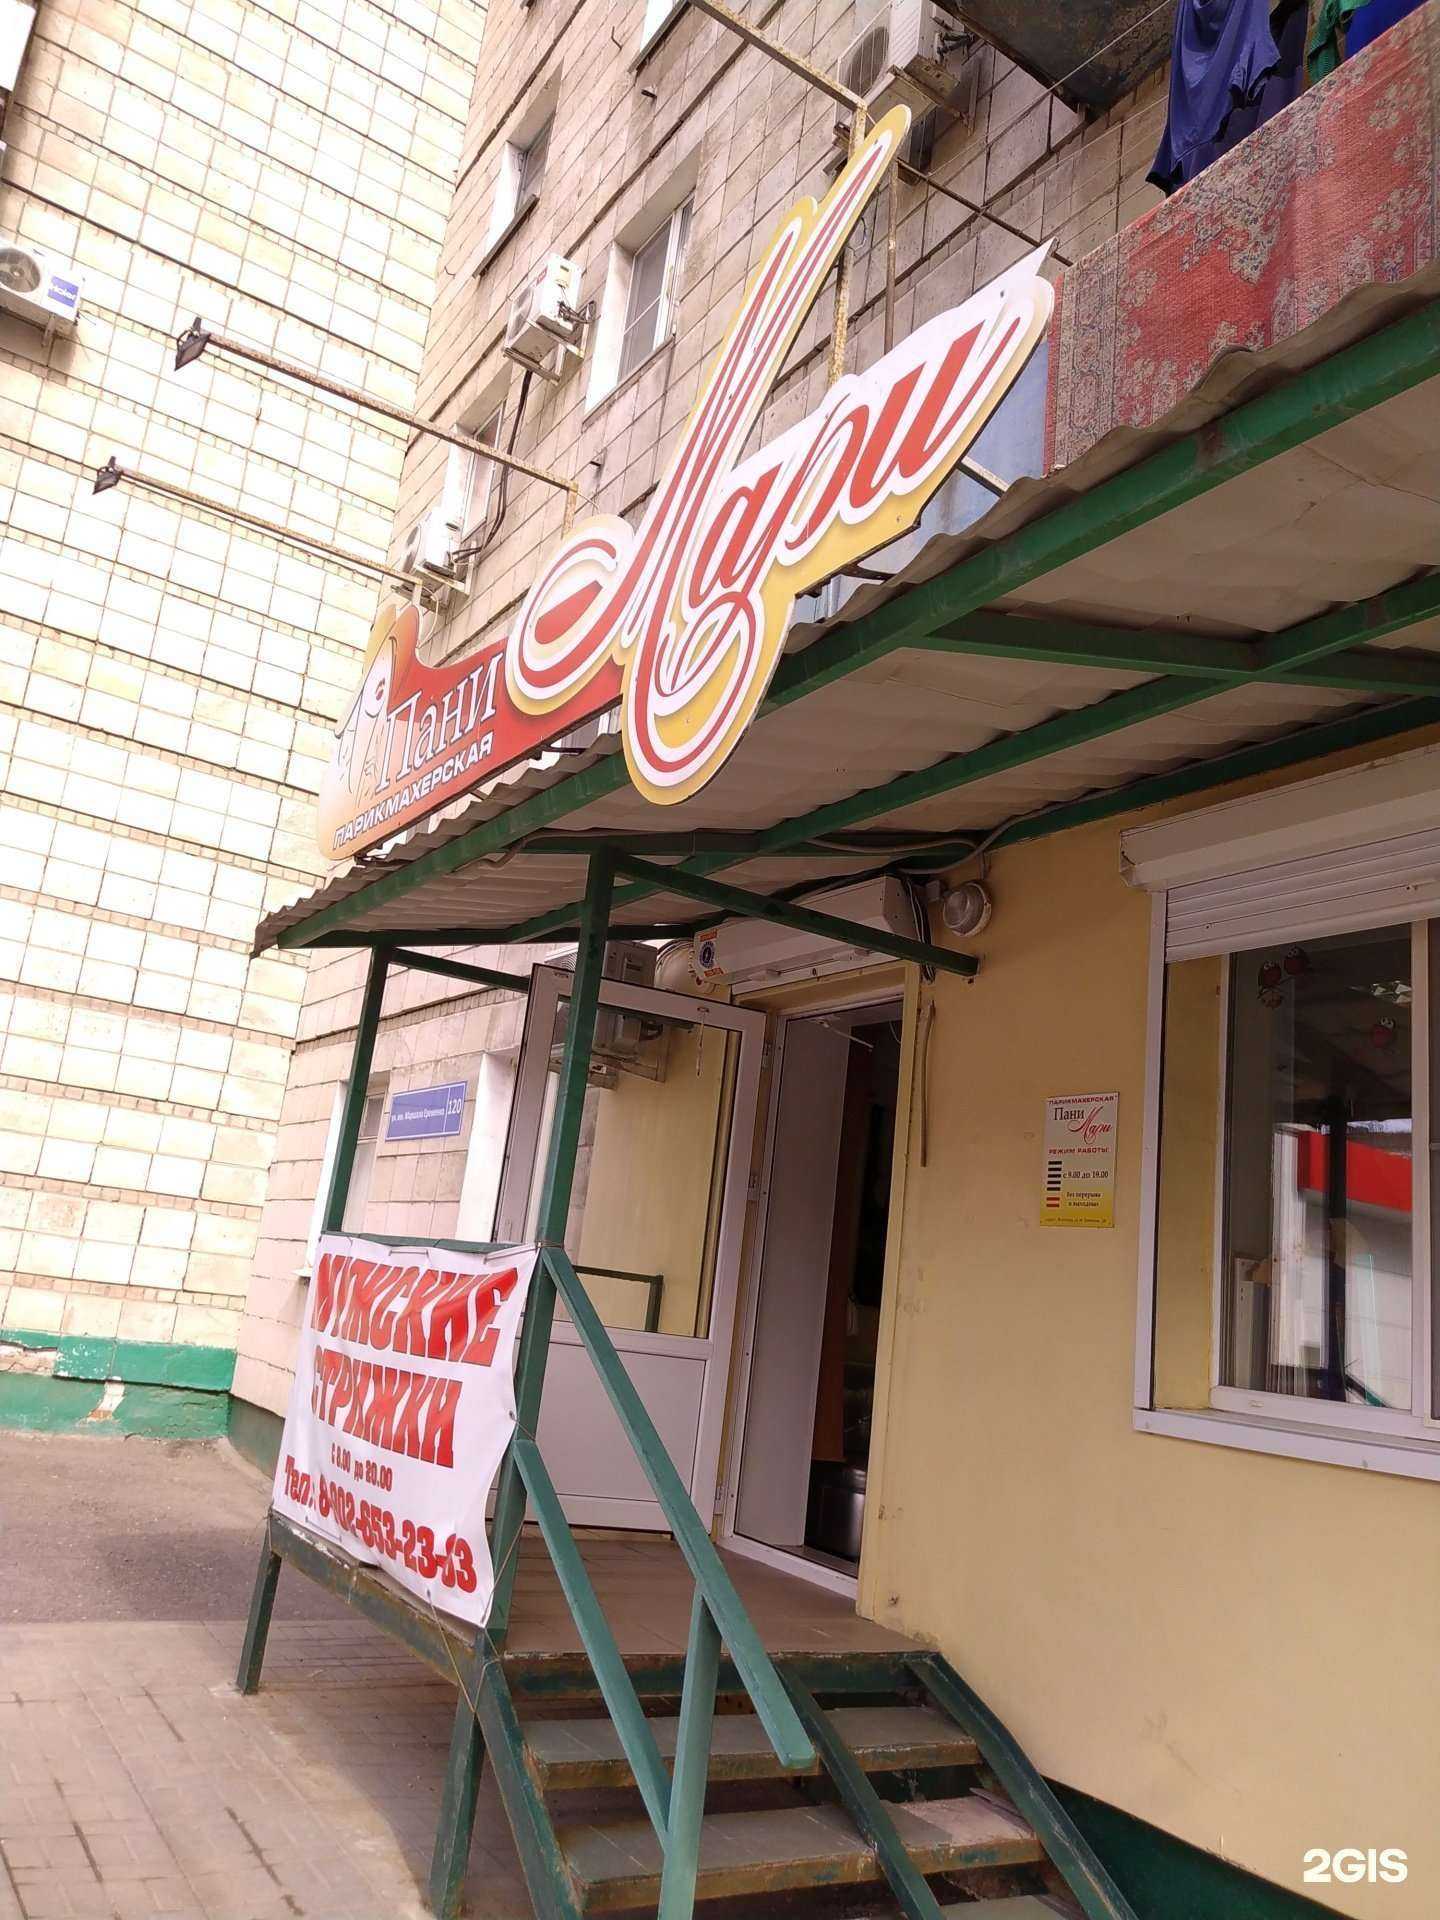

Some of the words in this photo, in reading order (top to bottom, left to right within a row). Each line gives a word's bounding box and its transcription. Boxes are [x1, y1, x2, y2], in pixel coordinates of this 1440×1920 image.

[375, 652, 504, 794] Пани
[333, 731, 494, 850] ПАРИКМАХЕРСКАЯ
[448, 1098, 462, 1115] 120
[1054, 1107, 1085, 1120] Пани
[311, 1345, 463, 1468] СТРИЖКИ
[354, 1460, 363, 1482] до
[365, 1459, 393, 1492] 20.00
